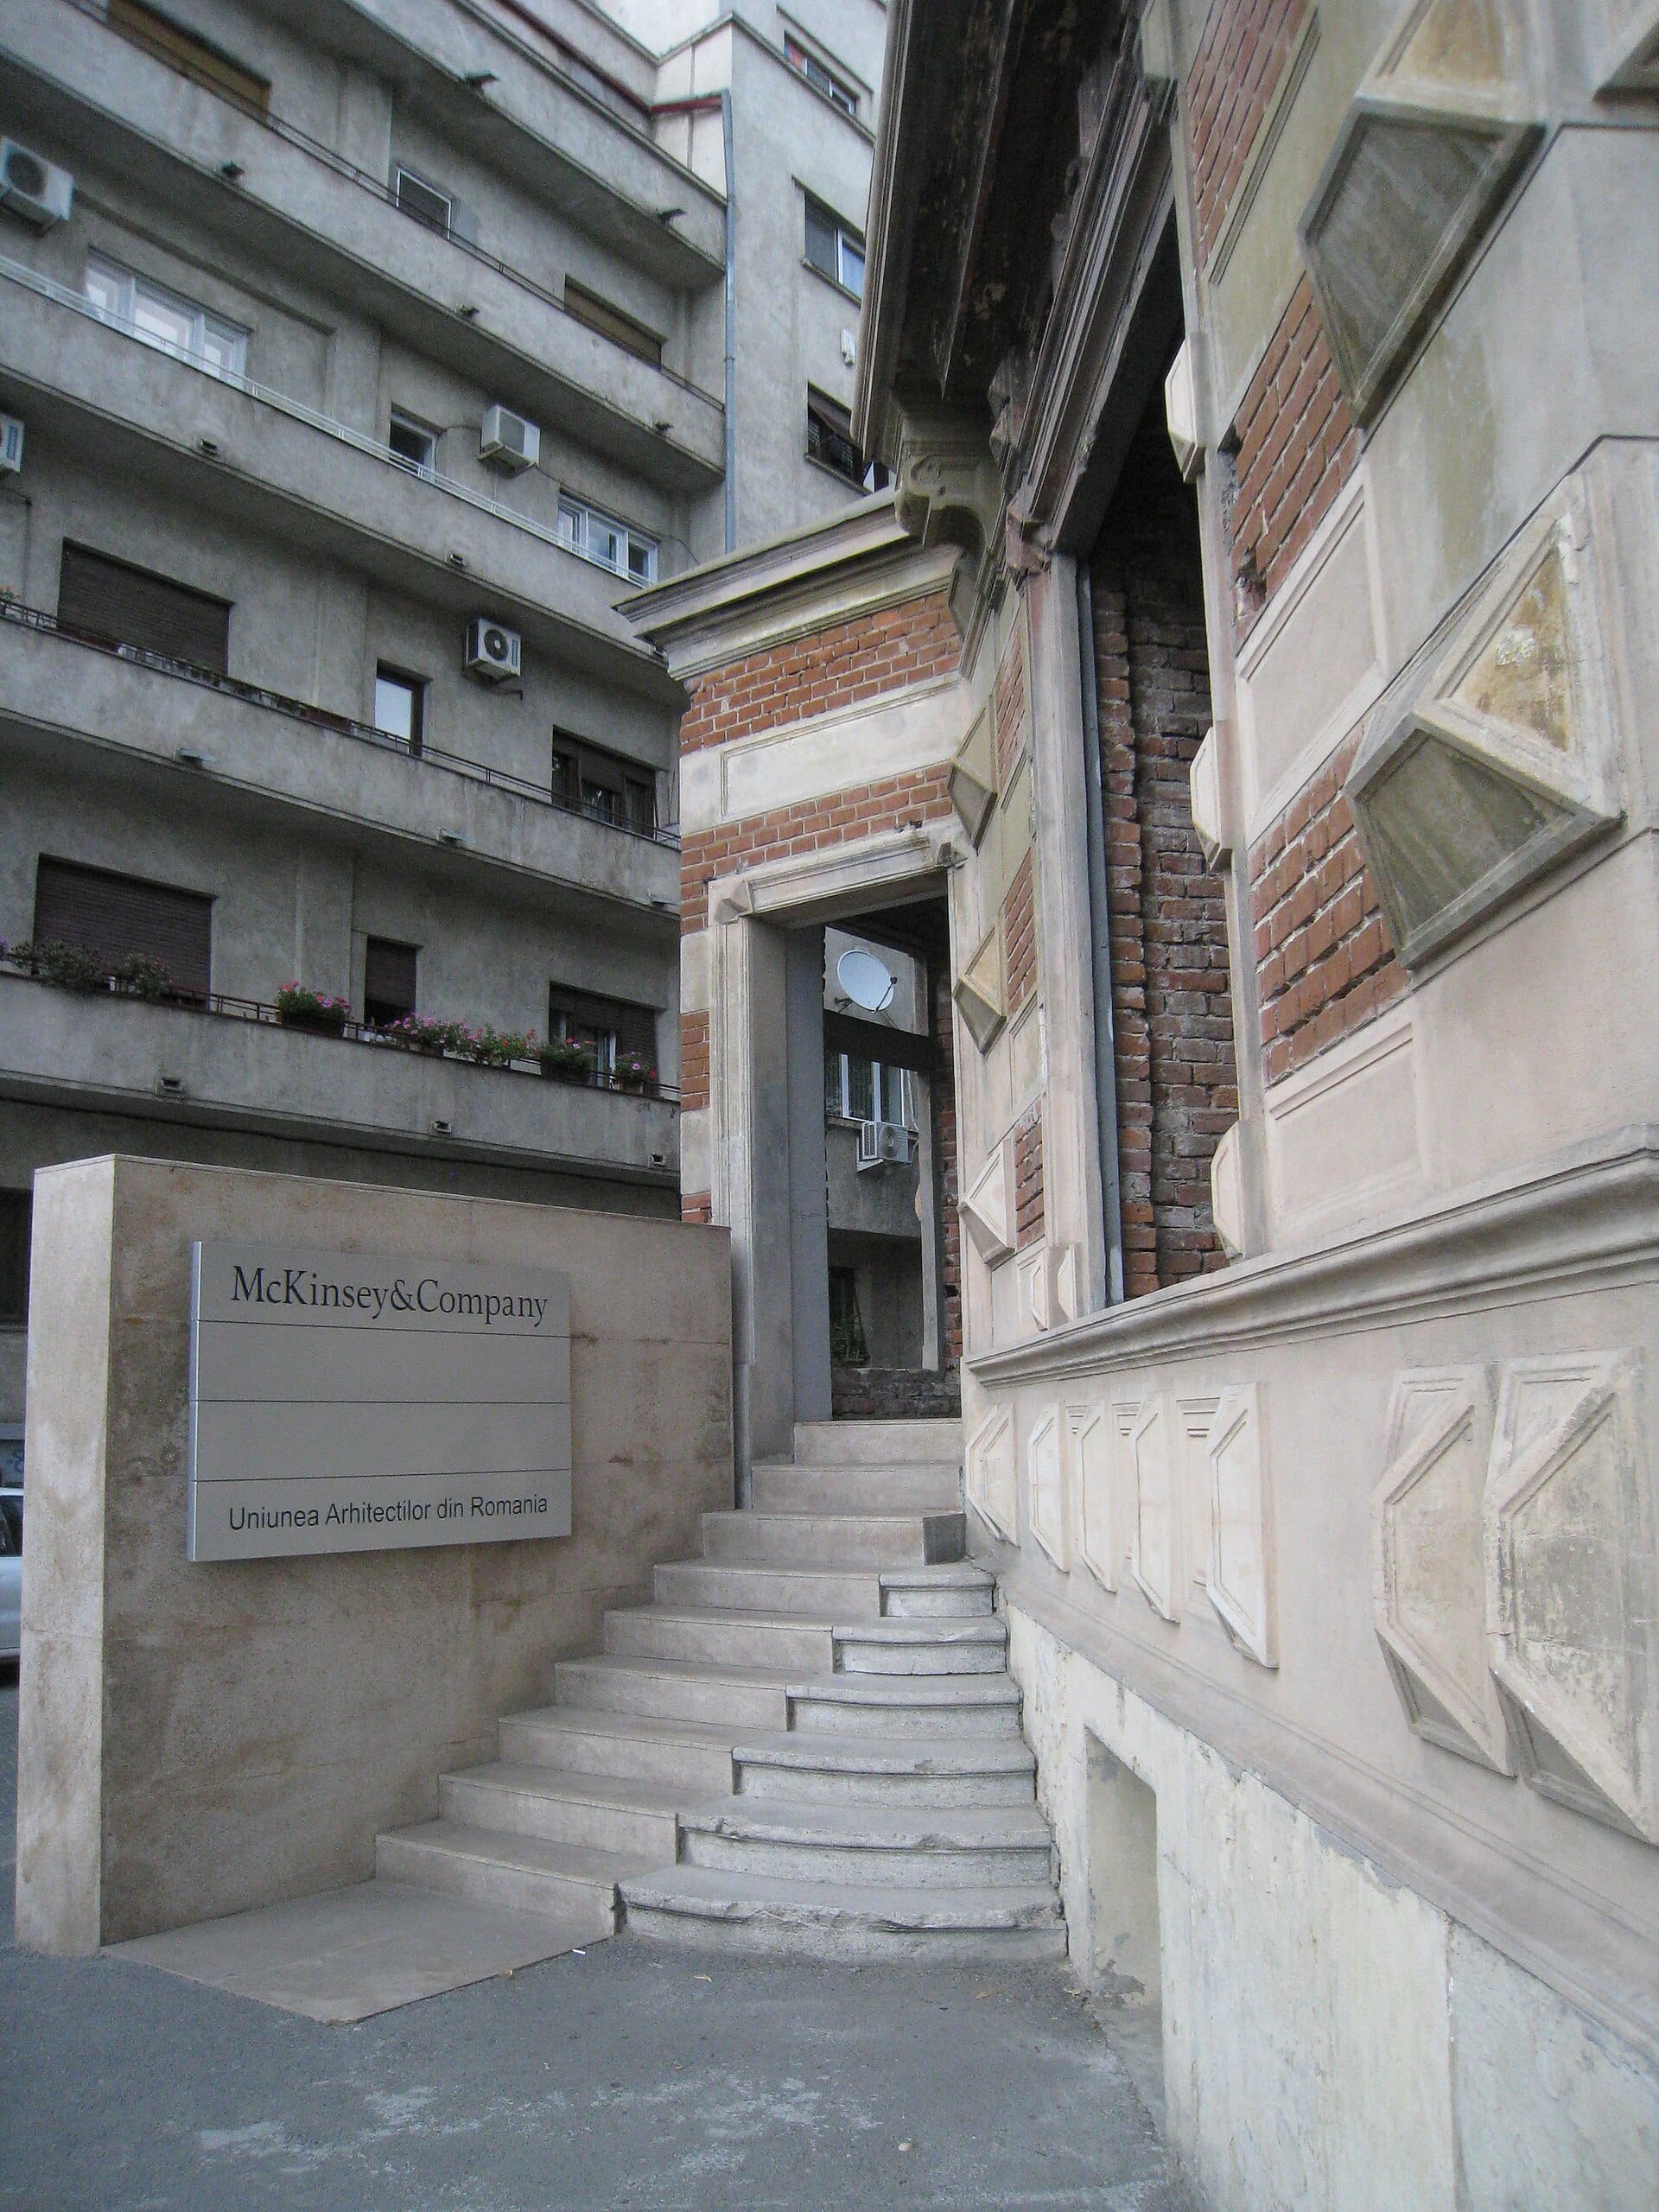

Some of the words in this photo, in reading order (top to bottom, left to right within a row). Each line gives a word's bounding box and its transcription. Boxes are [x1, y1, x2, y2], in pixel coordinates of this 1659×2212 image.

[232, 1265, 548, 1327] McKinsey&Company
[229, 1506, 319, 1530] Uniunea
[325, 1499, 431, 1525] Arhitectilor
[437, 1497, 464, 1520] din
[472, 1494, 548, 1516] Romania
